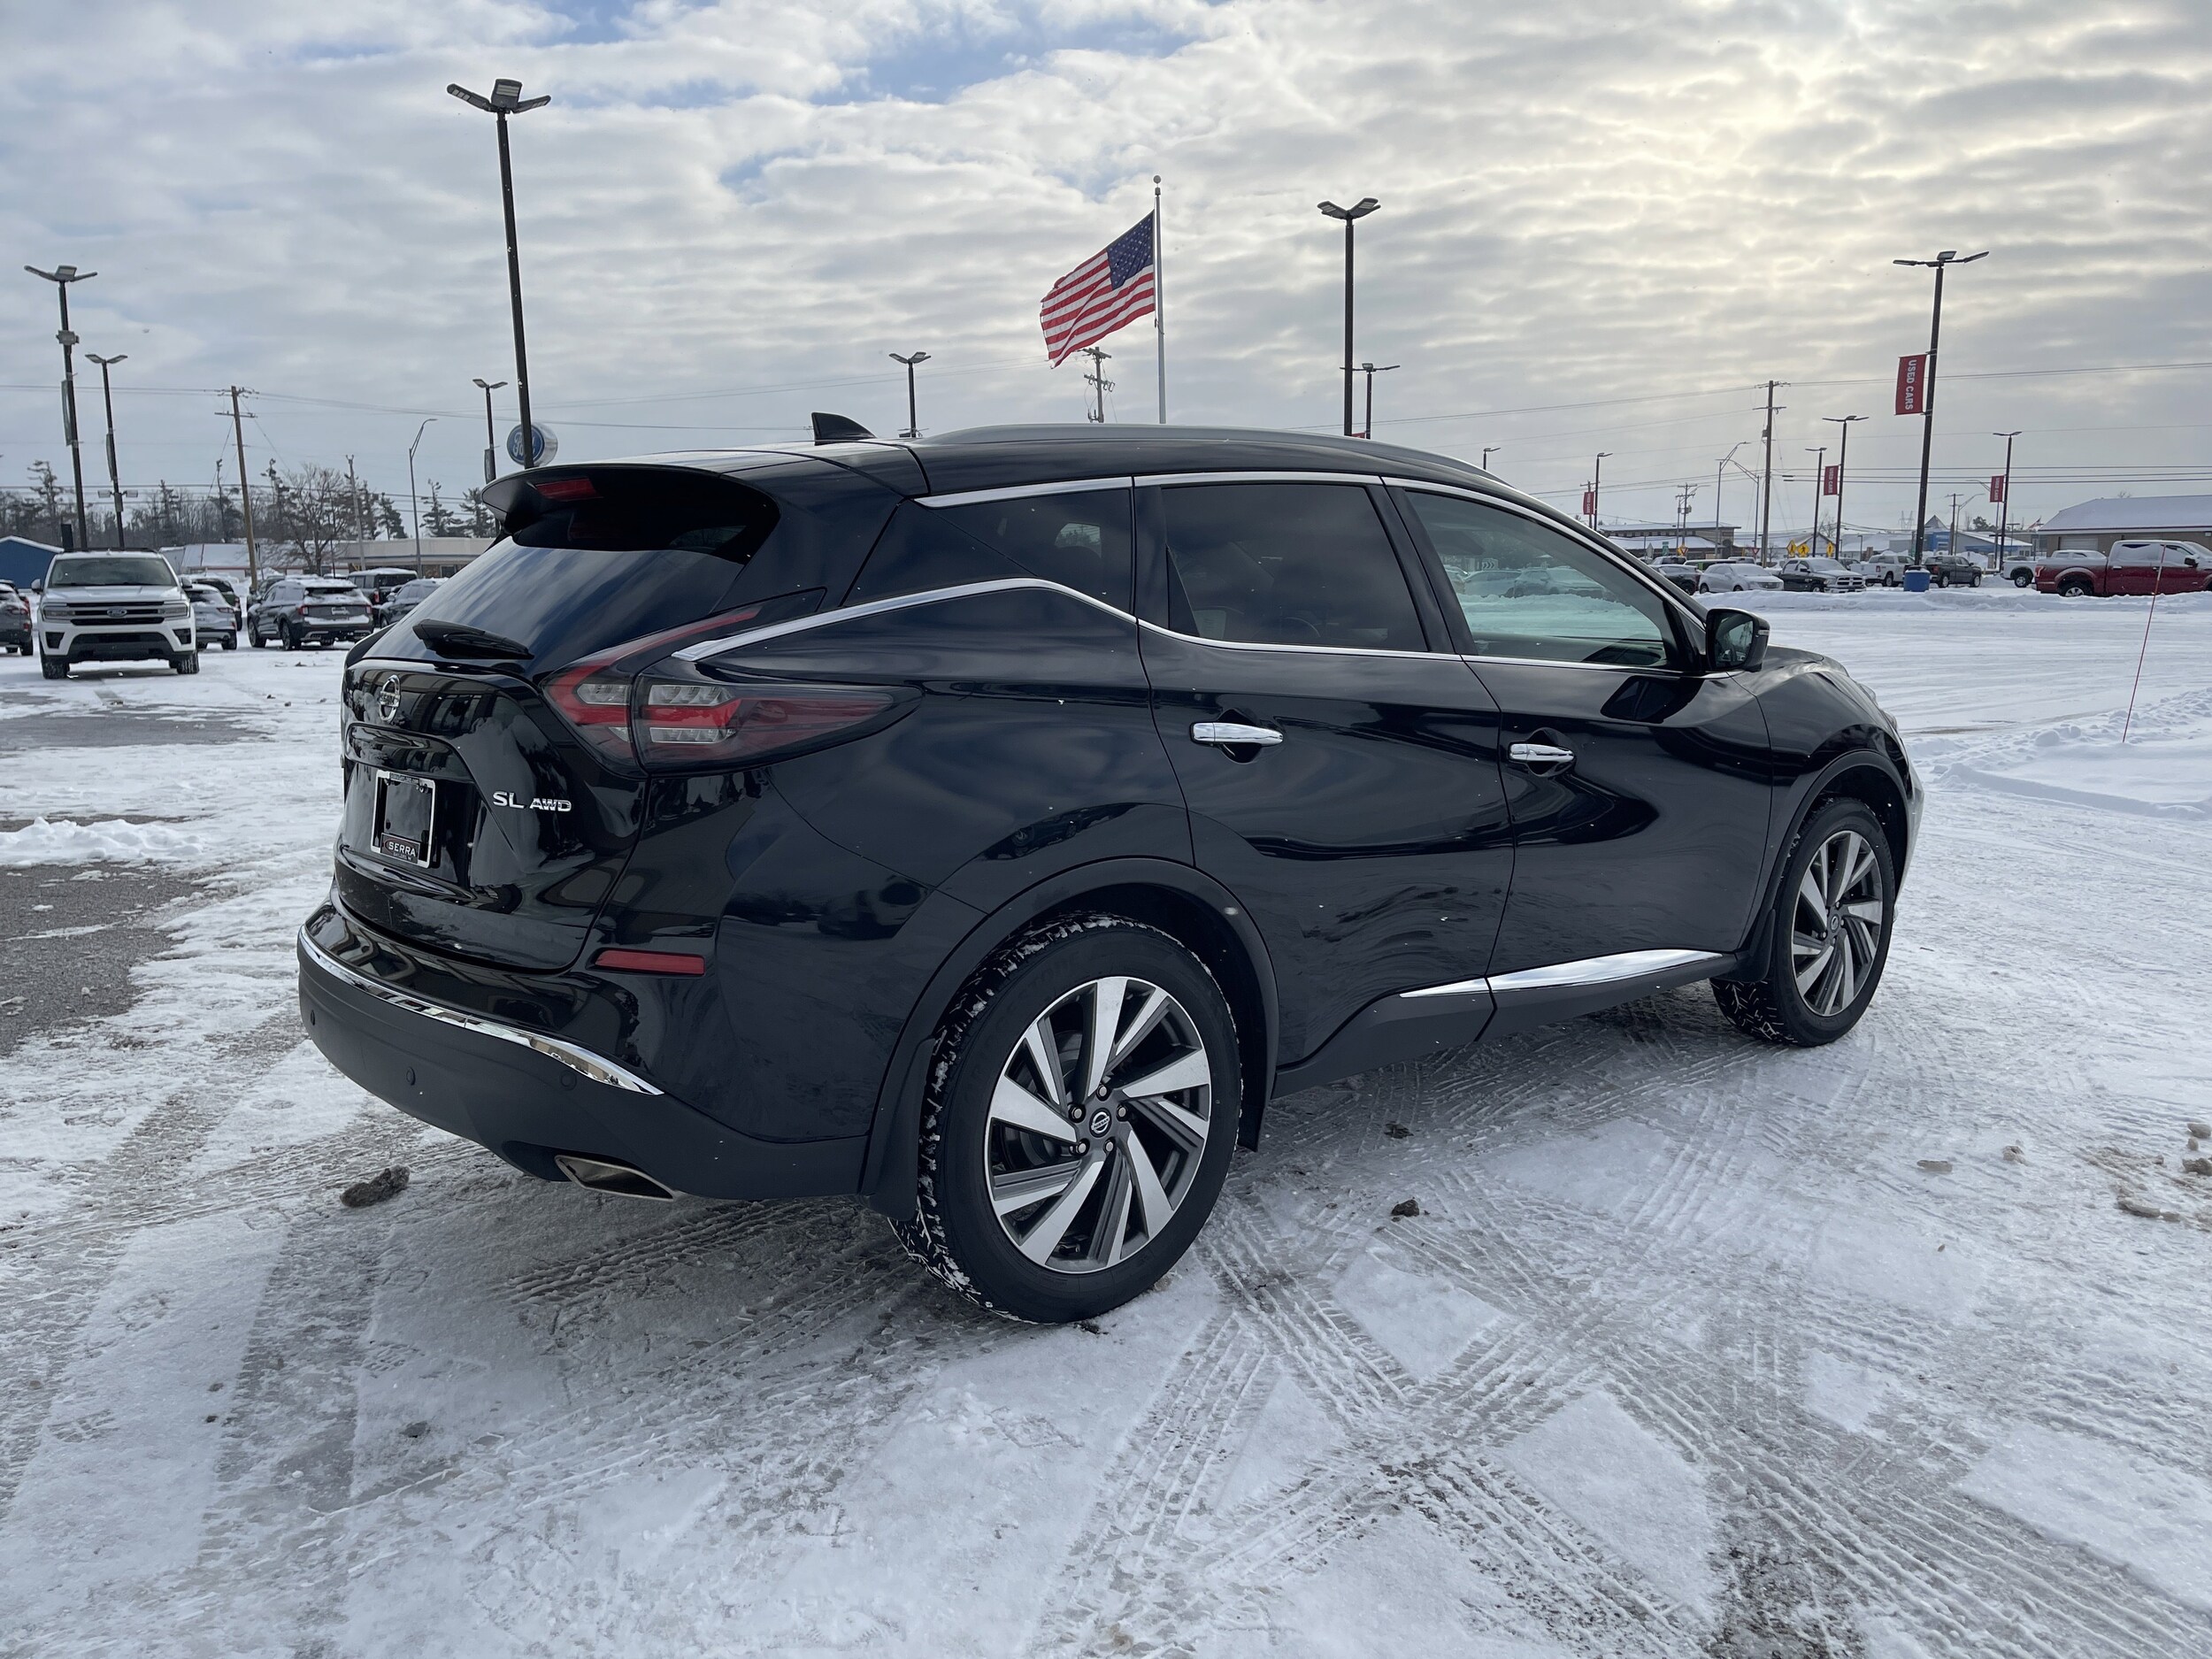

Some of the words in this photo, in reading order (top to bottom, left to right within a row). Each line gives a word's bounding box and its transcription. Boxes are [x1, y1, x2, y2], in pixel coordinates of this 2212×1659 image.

[1906, 359, 1916, 383] USED
[1905, 386, 1914, 410] CARS
[493, 790, 525, 809] SL
[529, 797, 572, 812] AWD
[388, 841, 416, 856] SERRA
